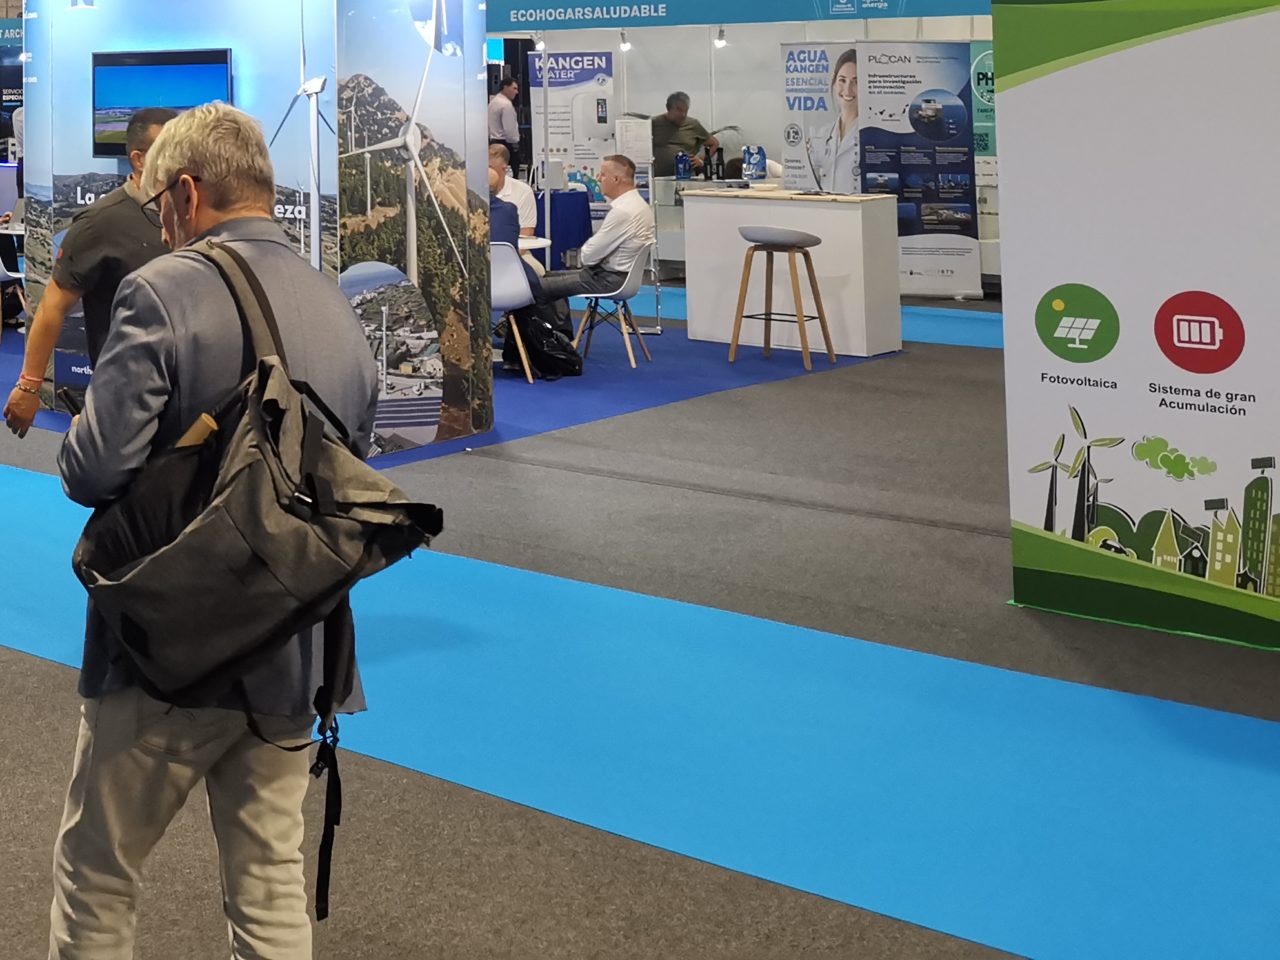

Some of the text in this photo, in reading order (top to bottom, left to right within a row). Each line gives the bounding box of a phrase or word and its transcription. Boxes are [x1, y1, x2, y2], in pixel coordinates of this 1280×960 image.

[510, 4, 667, 22] ECOHOGARSALUDABLE
[535, 56, 606, 70] KANGEN
[786, 50, 829, 64] AGUA
[785, 64, 829, 74] KANGEN
[785, 77, 829, 86] ESENCIAL
[785, 96, 828, 111] VIDA
[76, 187, 94, 204] La
[274, 203, 306, 219] eza
[1041, 372, 1118, 389] Fotovoltaica
[1149, 382, 1256, 403] Sistema de gran
[1158, 397, 1247, 416] Acumulación
